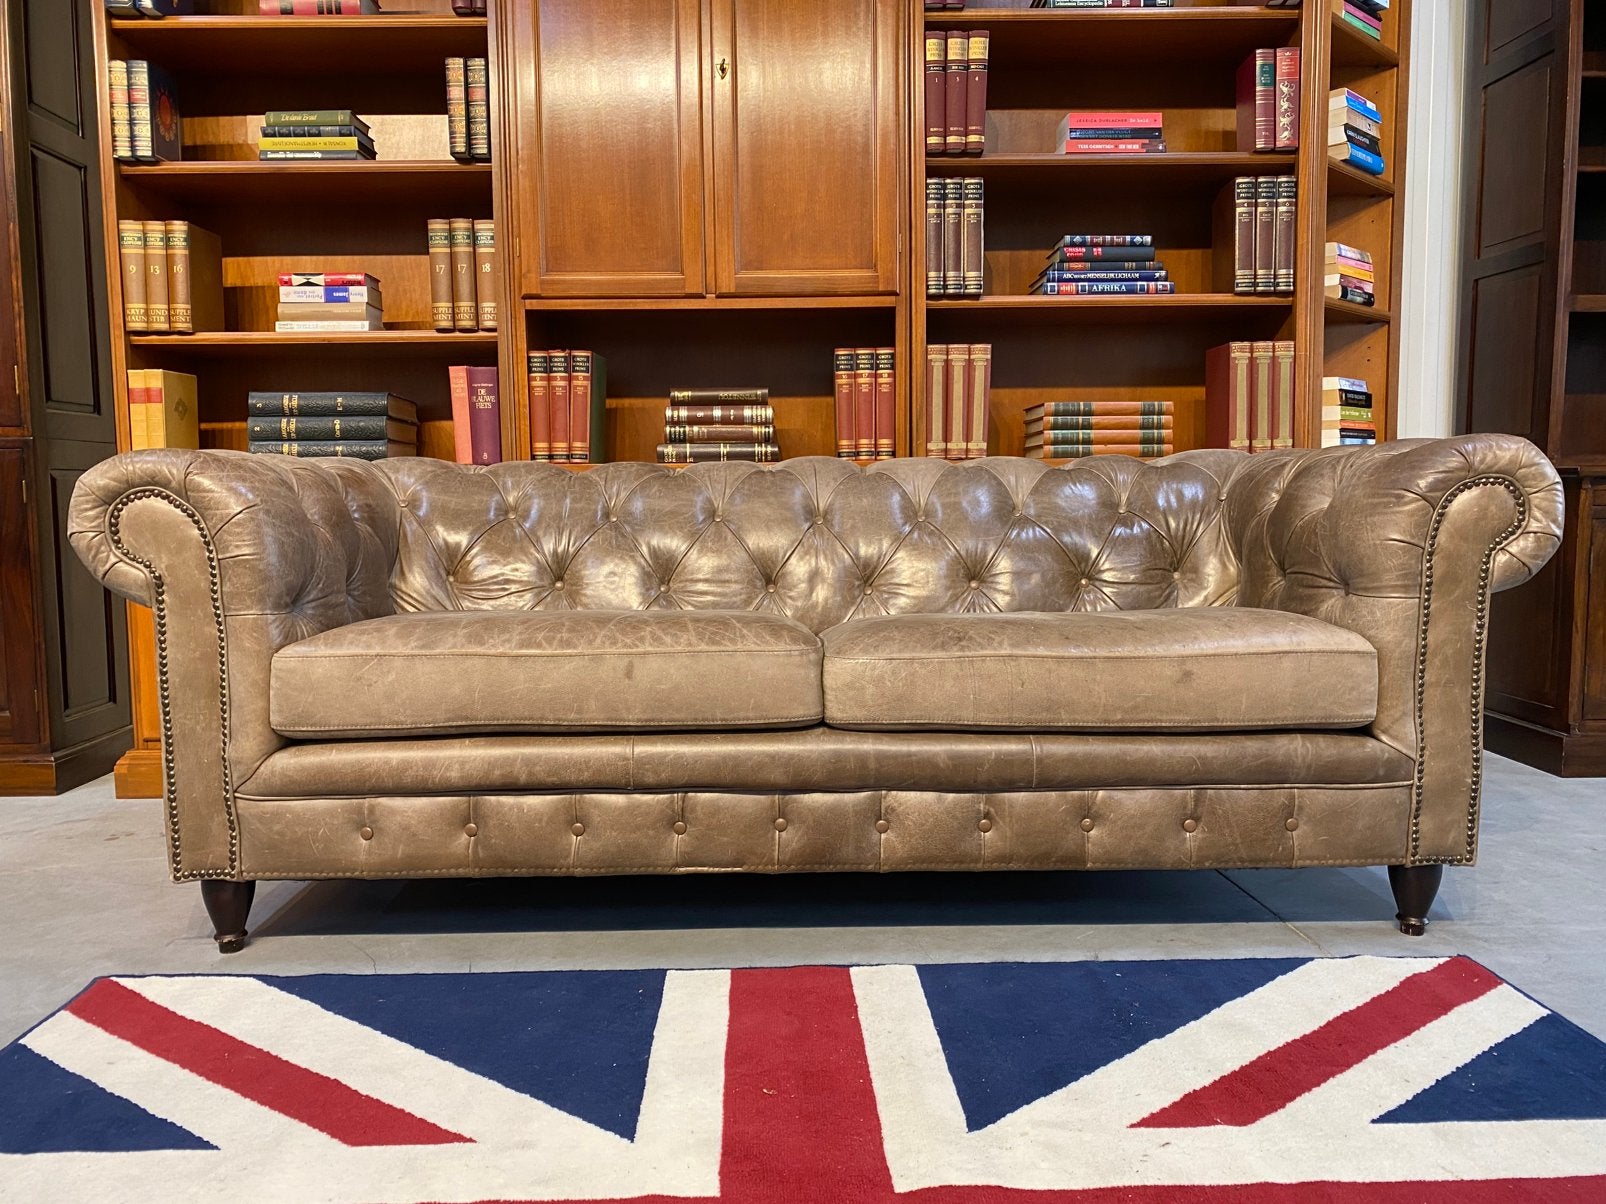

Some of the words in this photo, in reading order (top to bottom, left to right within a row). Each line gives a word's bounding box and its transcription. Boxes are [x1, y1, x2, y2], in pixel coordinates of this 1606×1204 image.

[129, 264, 136, 274] 9
[150, 265, 160, 274] 13
[173, 264, 183, 273] 16
[436, 264, 445, 274] 17
[457, 264, 467, 274] 17
[482, 262, 491, 273] 18
